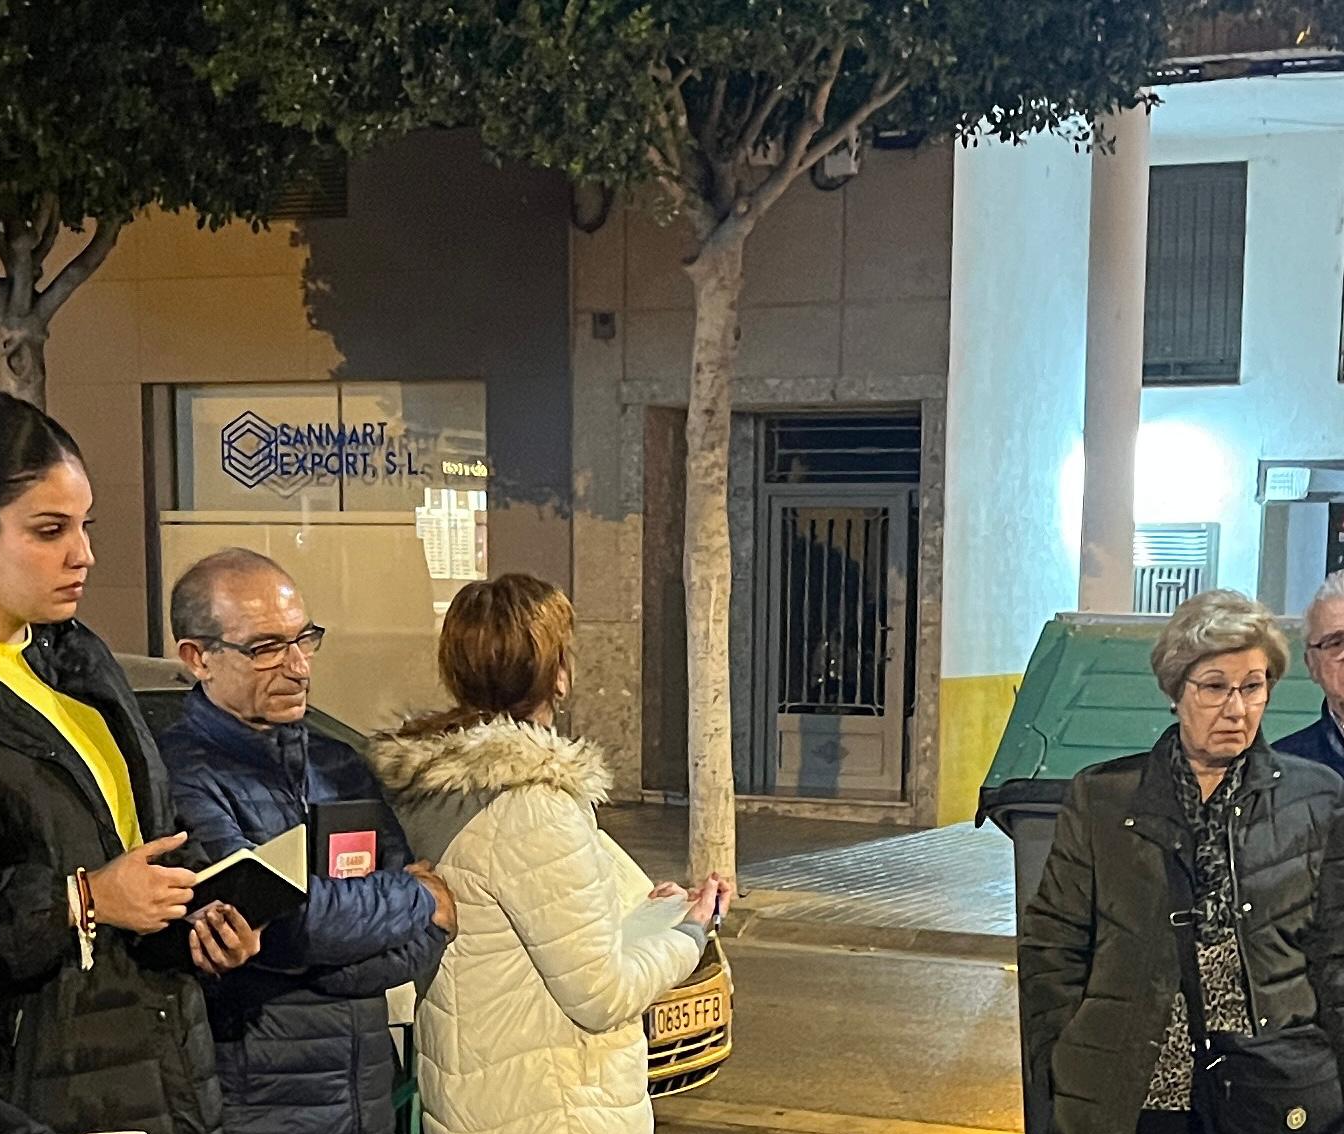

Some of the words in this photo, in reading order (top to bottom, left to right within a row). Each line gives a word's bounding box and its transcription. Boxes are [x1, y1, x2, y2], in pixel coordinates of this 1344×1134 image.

[279, 422, 388, 447] SANMART
[279, 452, 376, 478] EXPORT,
[657, 1003, 690, 1034] 0635
[694, 996, 720, 1026] FFB
